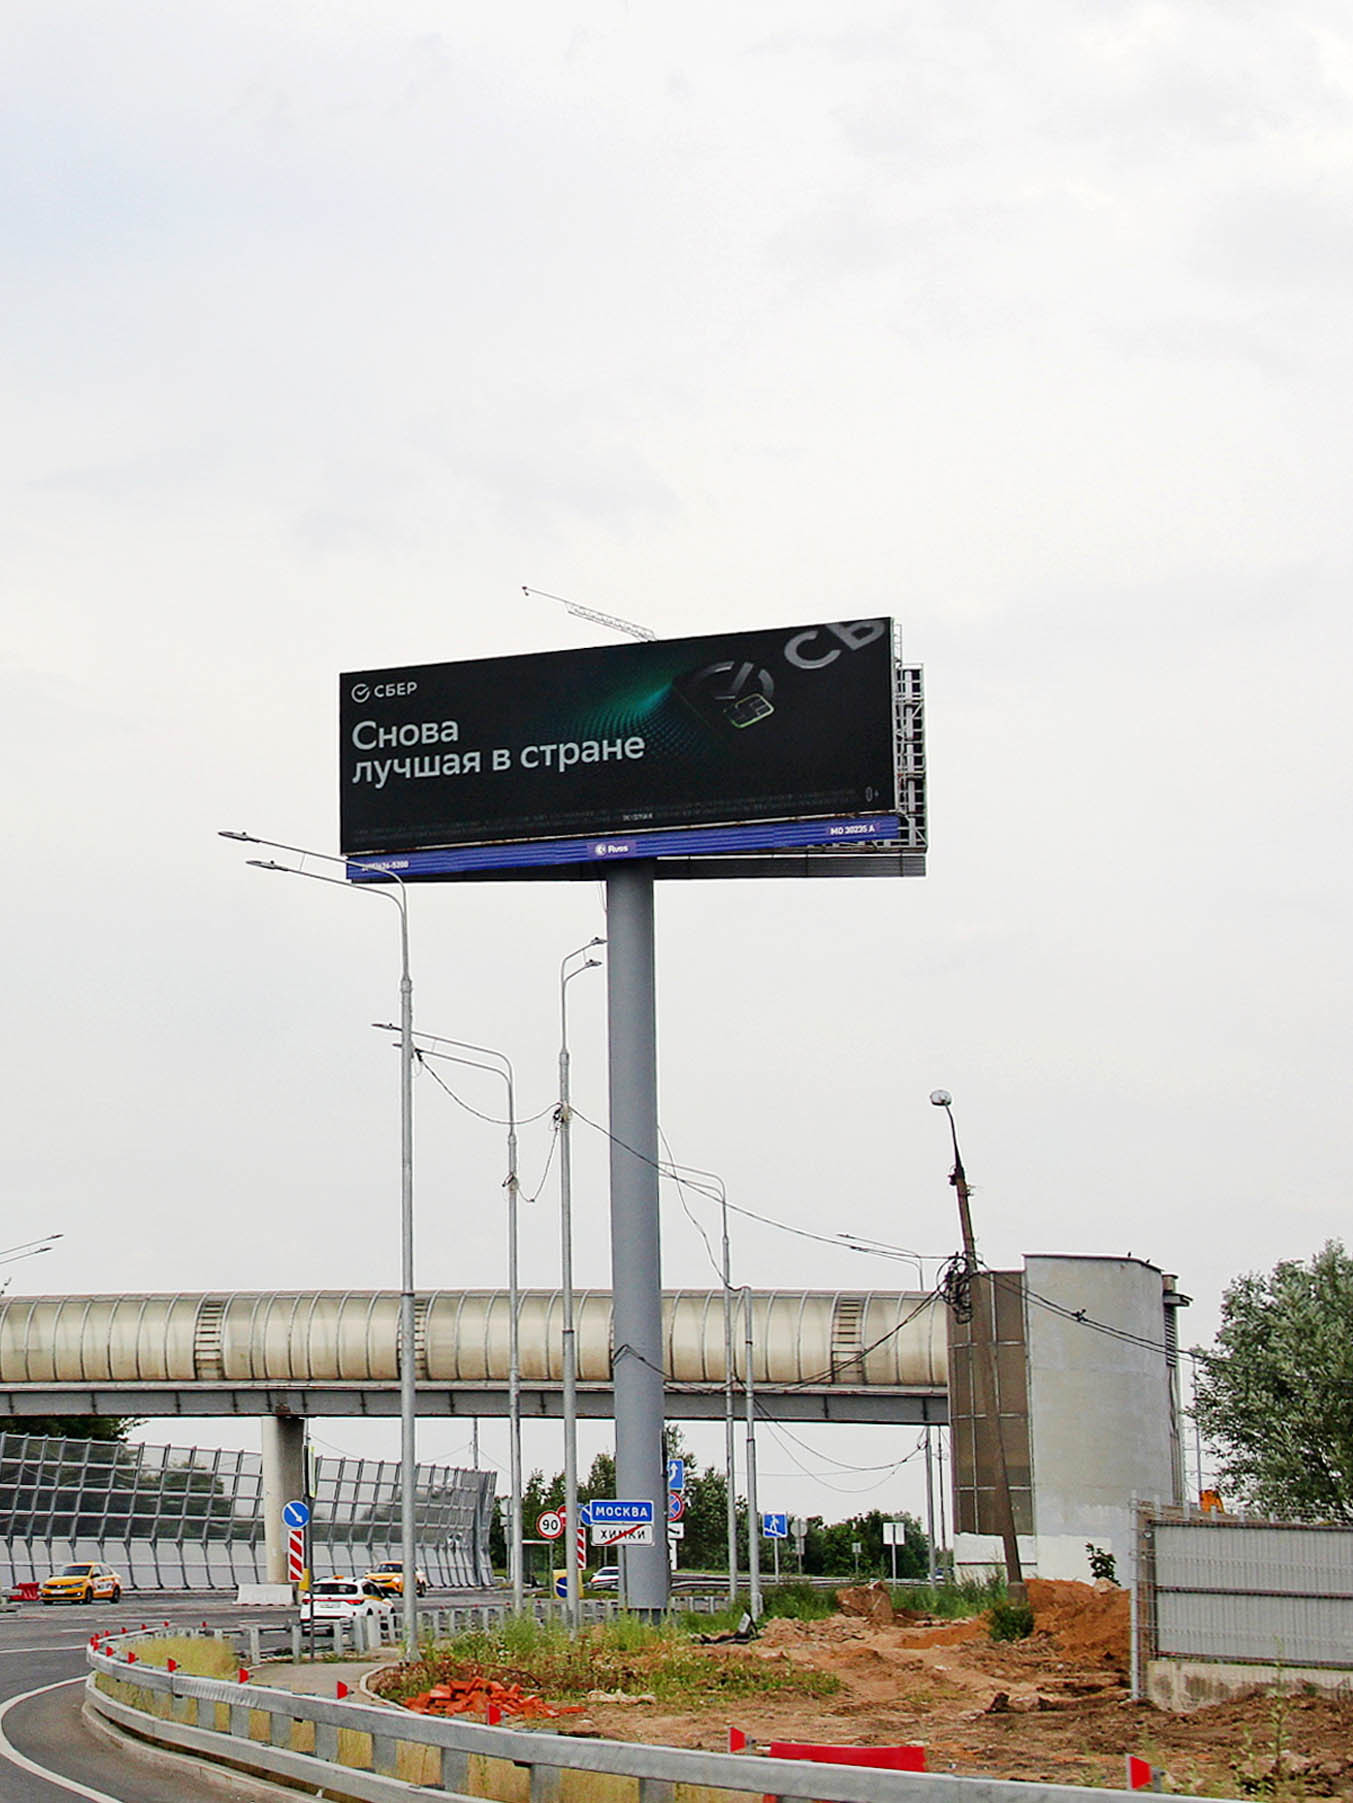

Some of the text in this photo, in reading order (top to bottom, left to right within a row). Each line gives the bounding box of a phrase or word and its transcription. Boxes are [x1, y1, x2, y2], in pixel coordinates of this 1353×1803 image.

[373, 681, 418, 698] СБЕР
[351, 720, 459, 750] Снова
[351, 736, 646, 789] лучшая в стране
[595, 1506, 648, 1518] МОСКВА
[542, 1519, 559, 1531] 90
[600, 1529, 646, 1540] ХИМКИ
